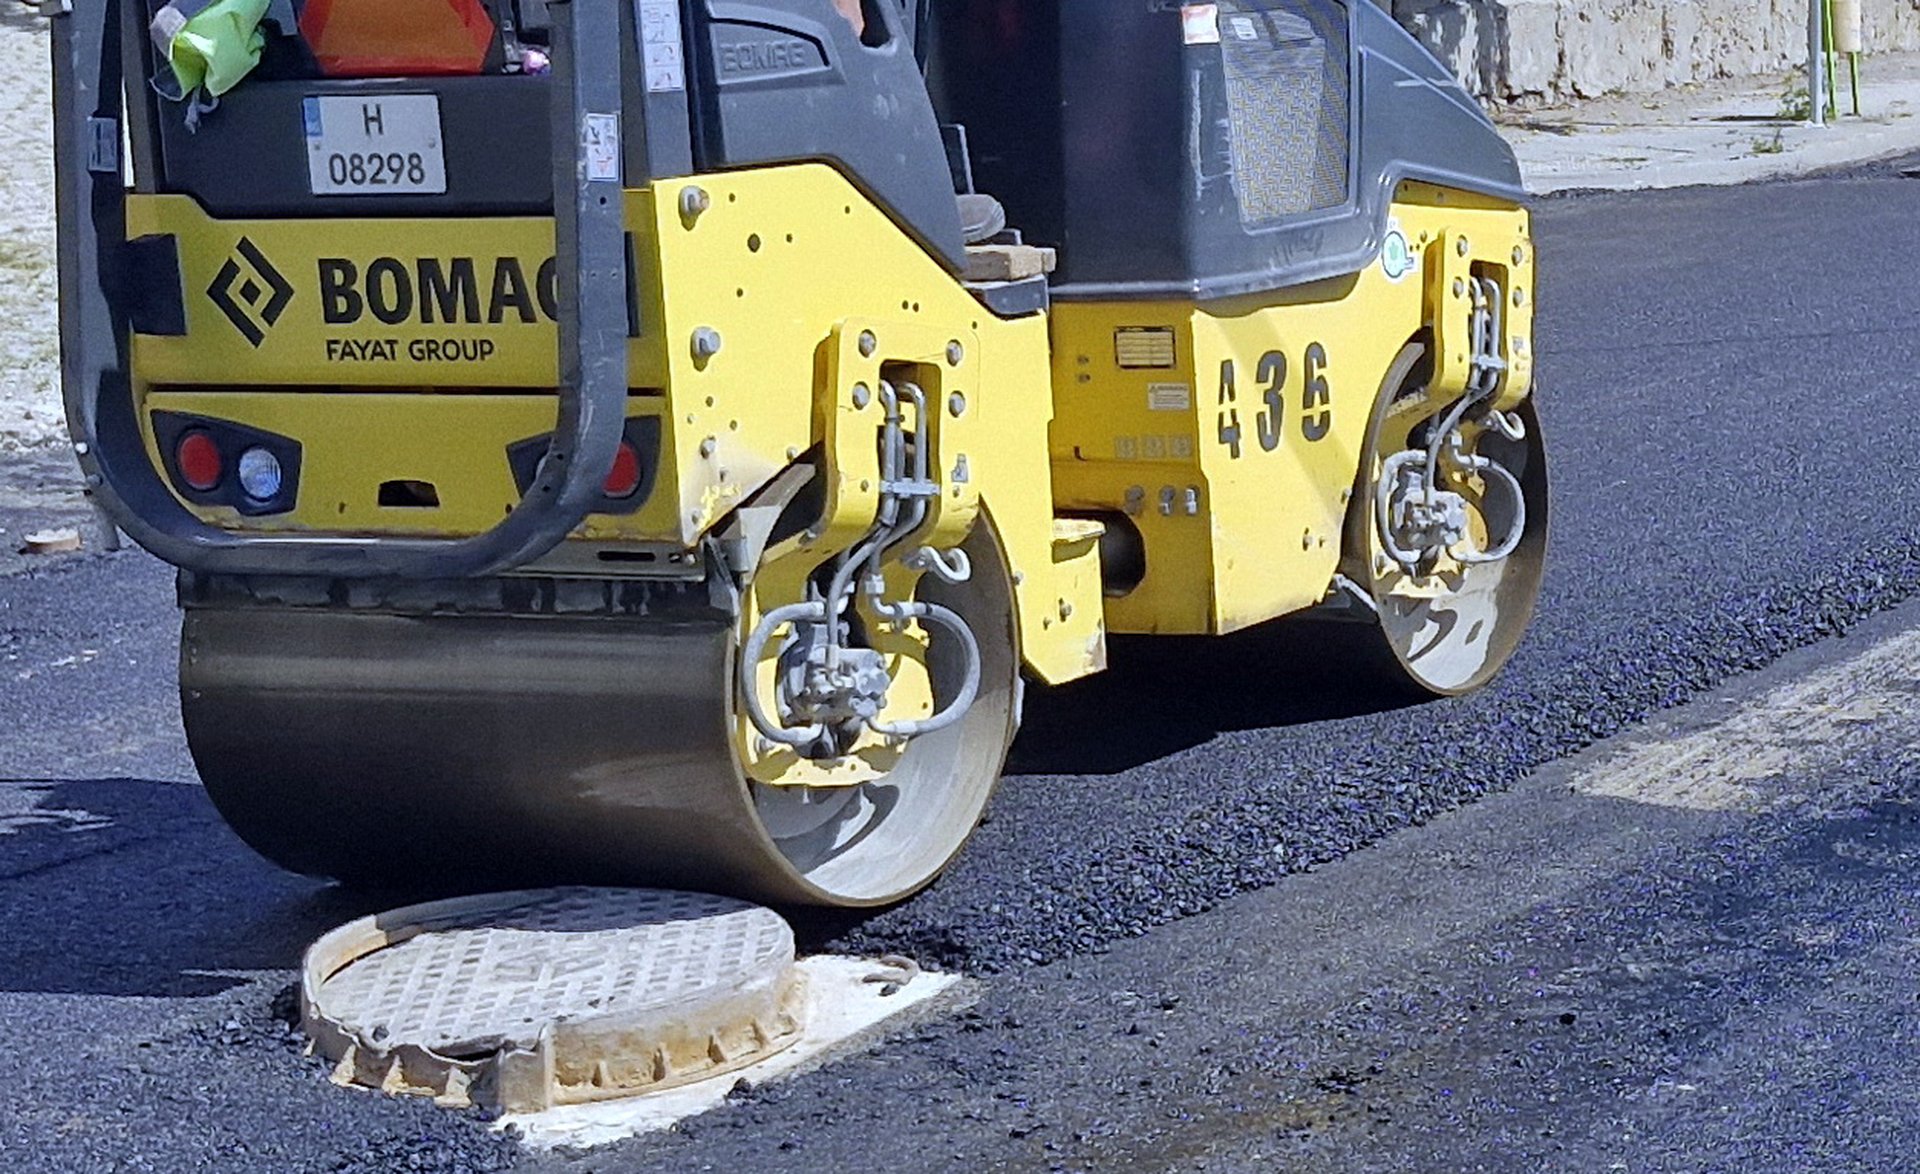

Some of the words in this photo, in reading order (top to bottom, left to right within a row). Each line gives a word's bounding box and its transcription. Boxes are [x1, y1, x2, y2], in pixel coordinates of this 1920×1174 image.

[362, 104, 384, 136] H
[328, 152, 426, 186] 08298
[326, 339, 398, 361] FAYAT
[408, 339, 495, 361] GROUP
[1217, 341, 1331, 460] 436
